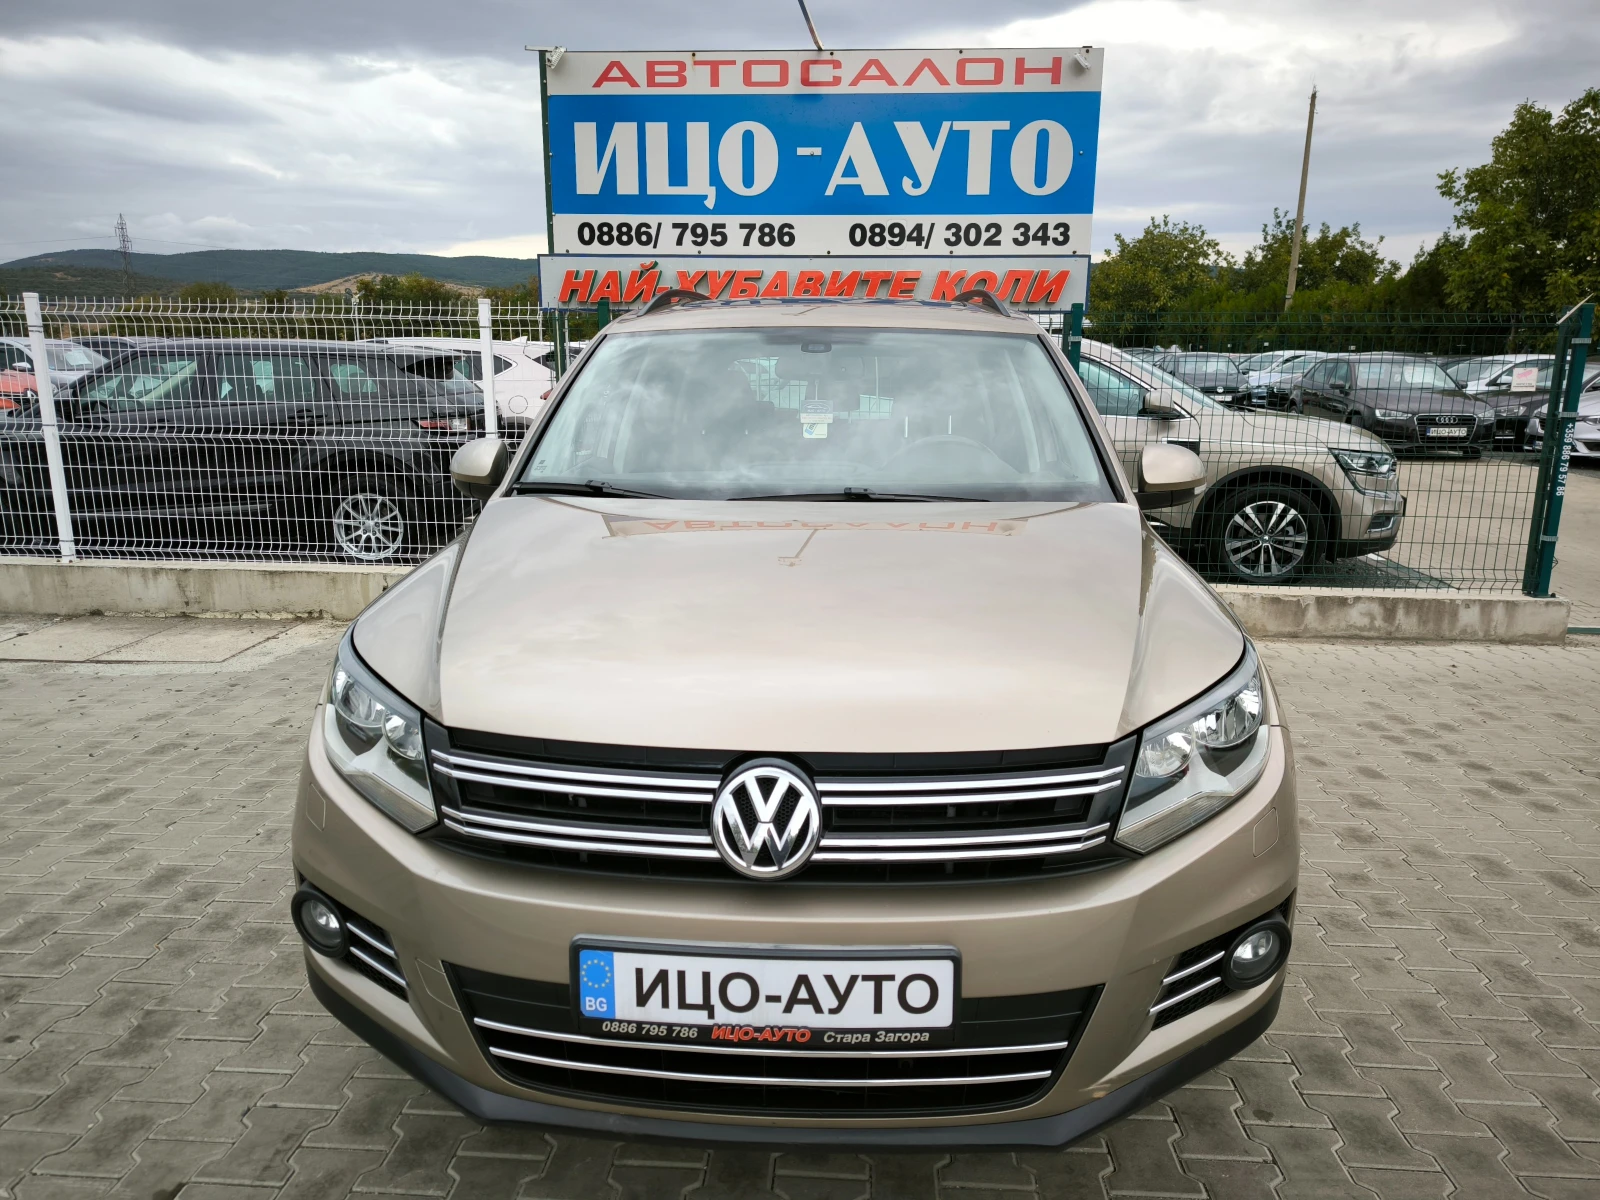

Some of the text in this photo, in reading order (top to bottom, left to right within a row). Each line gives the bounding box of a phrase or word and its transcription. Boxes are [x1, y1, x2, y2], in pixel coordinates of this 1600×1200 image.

[591, 56, 1063, 88] АВТОСАЛОН
[577, 221, 1071, 250] 0886/ 795 786 0894/ 302 343
[930, 269, 1072, 303] КОЛИ
[1564, 423, 1574, 443] +359
[1561, 445, 1572, 460] 886
[713, 766, 819, 873] VW
[634, 967, 940, 1020] ИЦО-АУТО
[585, 996, 608, 1012] BG
[602, 1021, 698, 1039] 0886 795 786
[711, 1024, 812, 1043] ИЦО-АУТО
[823, 1030, 930, 1044] Стара Загора
